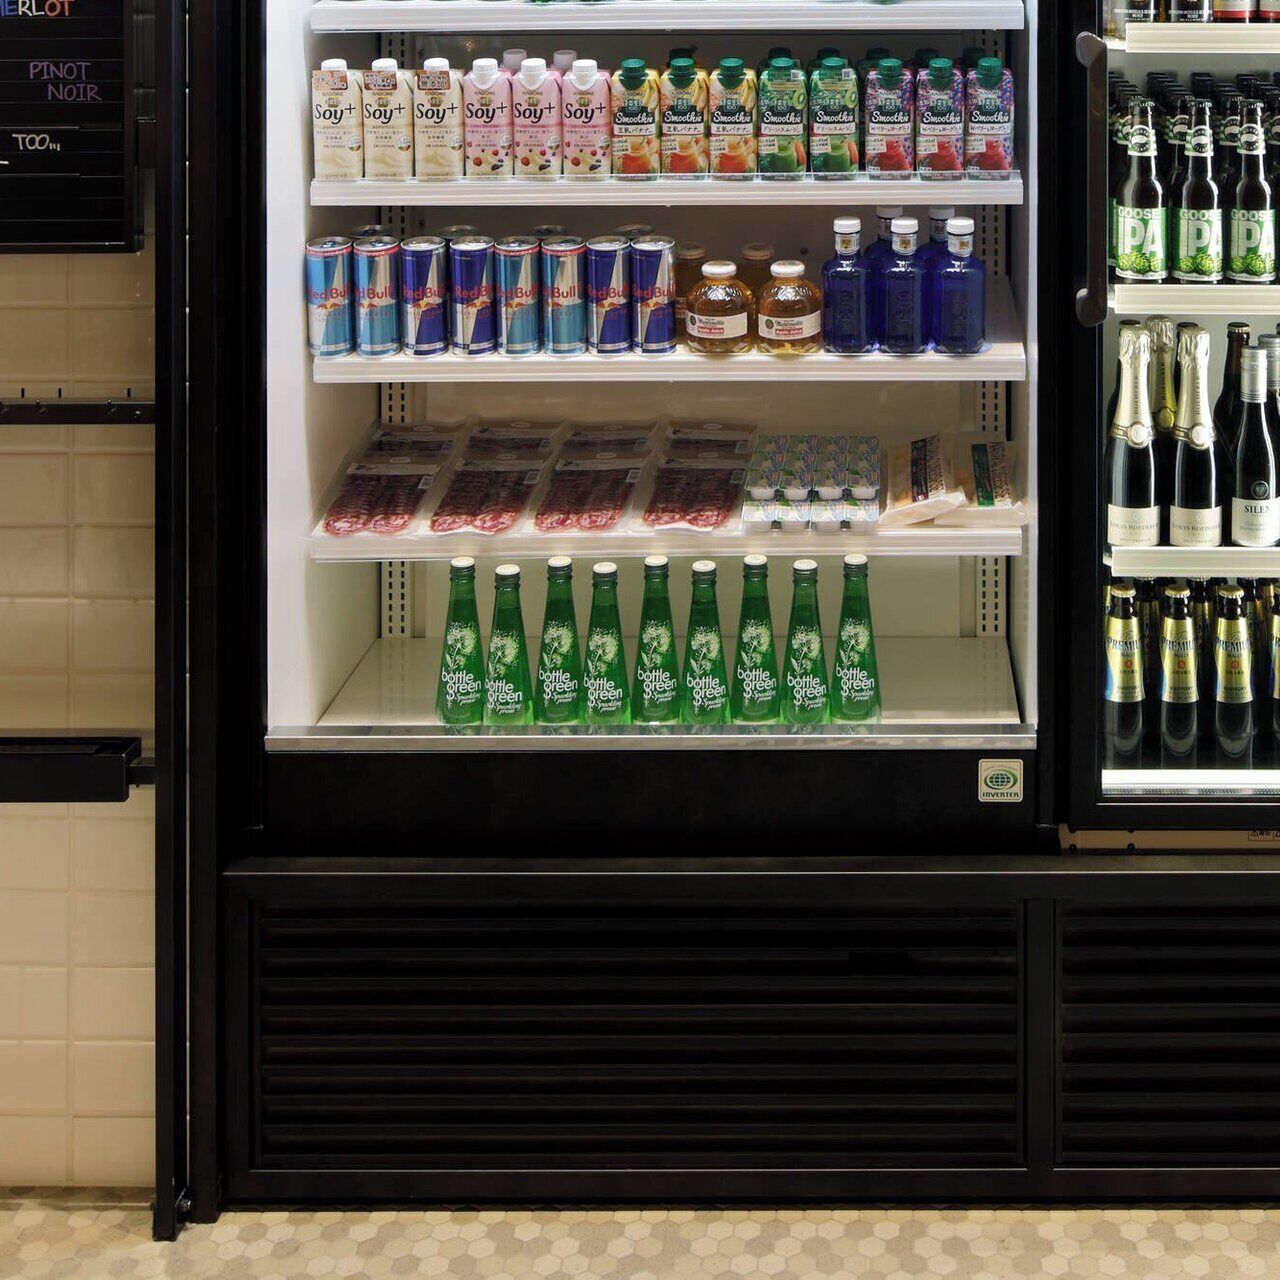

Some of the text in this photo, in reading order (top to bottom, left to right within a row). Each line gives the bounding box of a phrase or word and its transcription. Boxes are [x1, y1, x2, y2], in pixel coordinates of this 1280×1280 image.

[29, 61, 91, 81] PINOT
[47, 83, 102, 102] NOIR
[1118, 208, 1160, 219] GOOSE
[1244, 505, 1270, 514] SILEN
